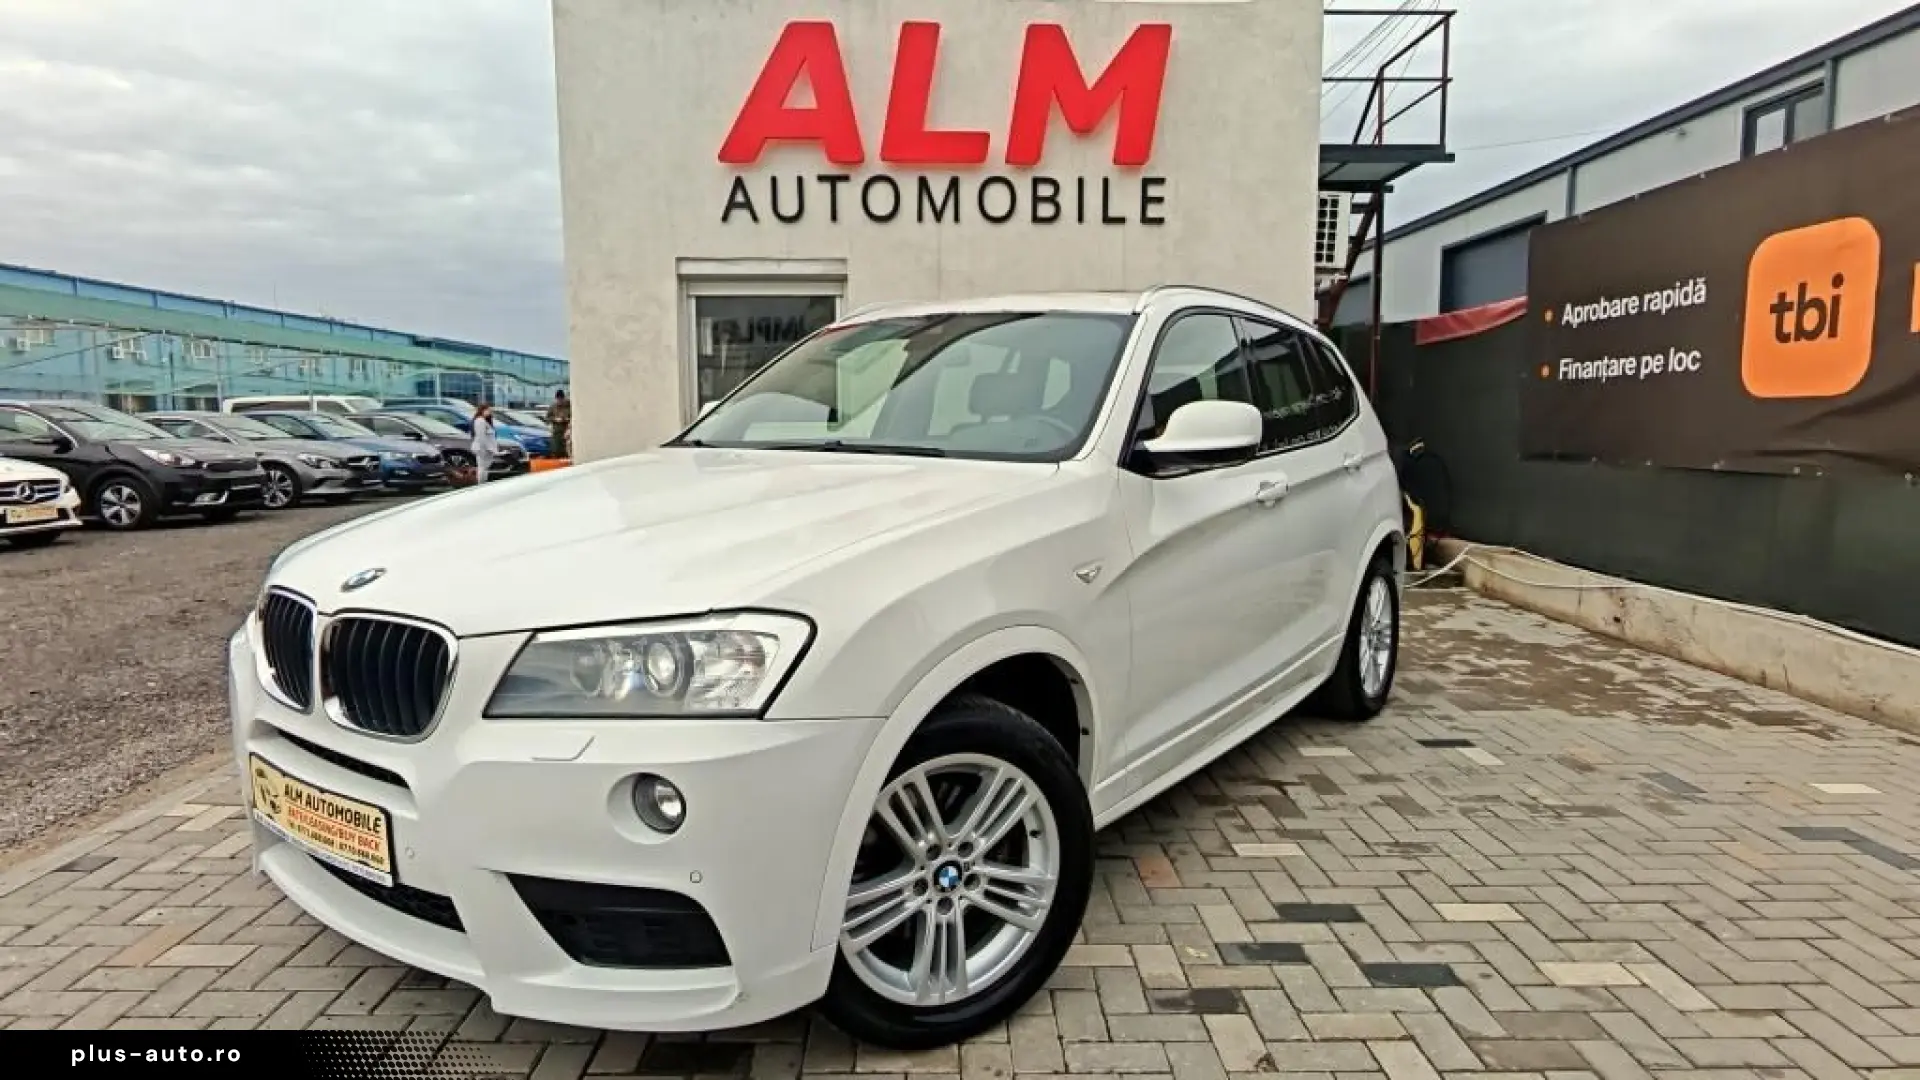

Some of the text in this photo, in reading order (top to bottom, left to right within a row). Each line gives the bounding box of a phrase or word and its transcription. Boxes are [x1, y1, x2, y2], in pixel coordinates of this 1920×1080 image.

[718, 20, 1172, 166] ALM
[721, 174, 1167, 225] AUTOMOBILE
[1561, 277, 1707, 328] Aprobare rapidă
[1769, 273, 1845, 344] tbi
[1558, 346, 1702, 383] Finanțare pe loc
[284, 783, 382, 834] ALM AUTOMOBILE
